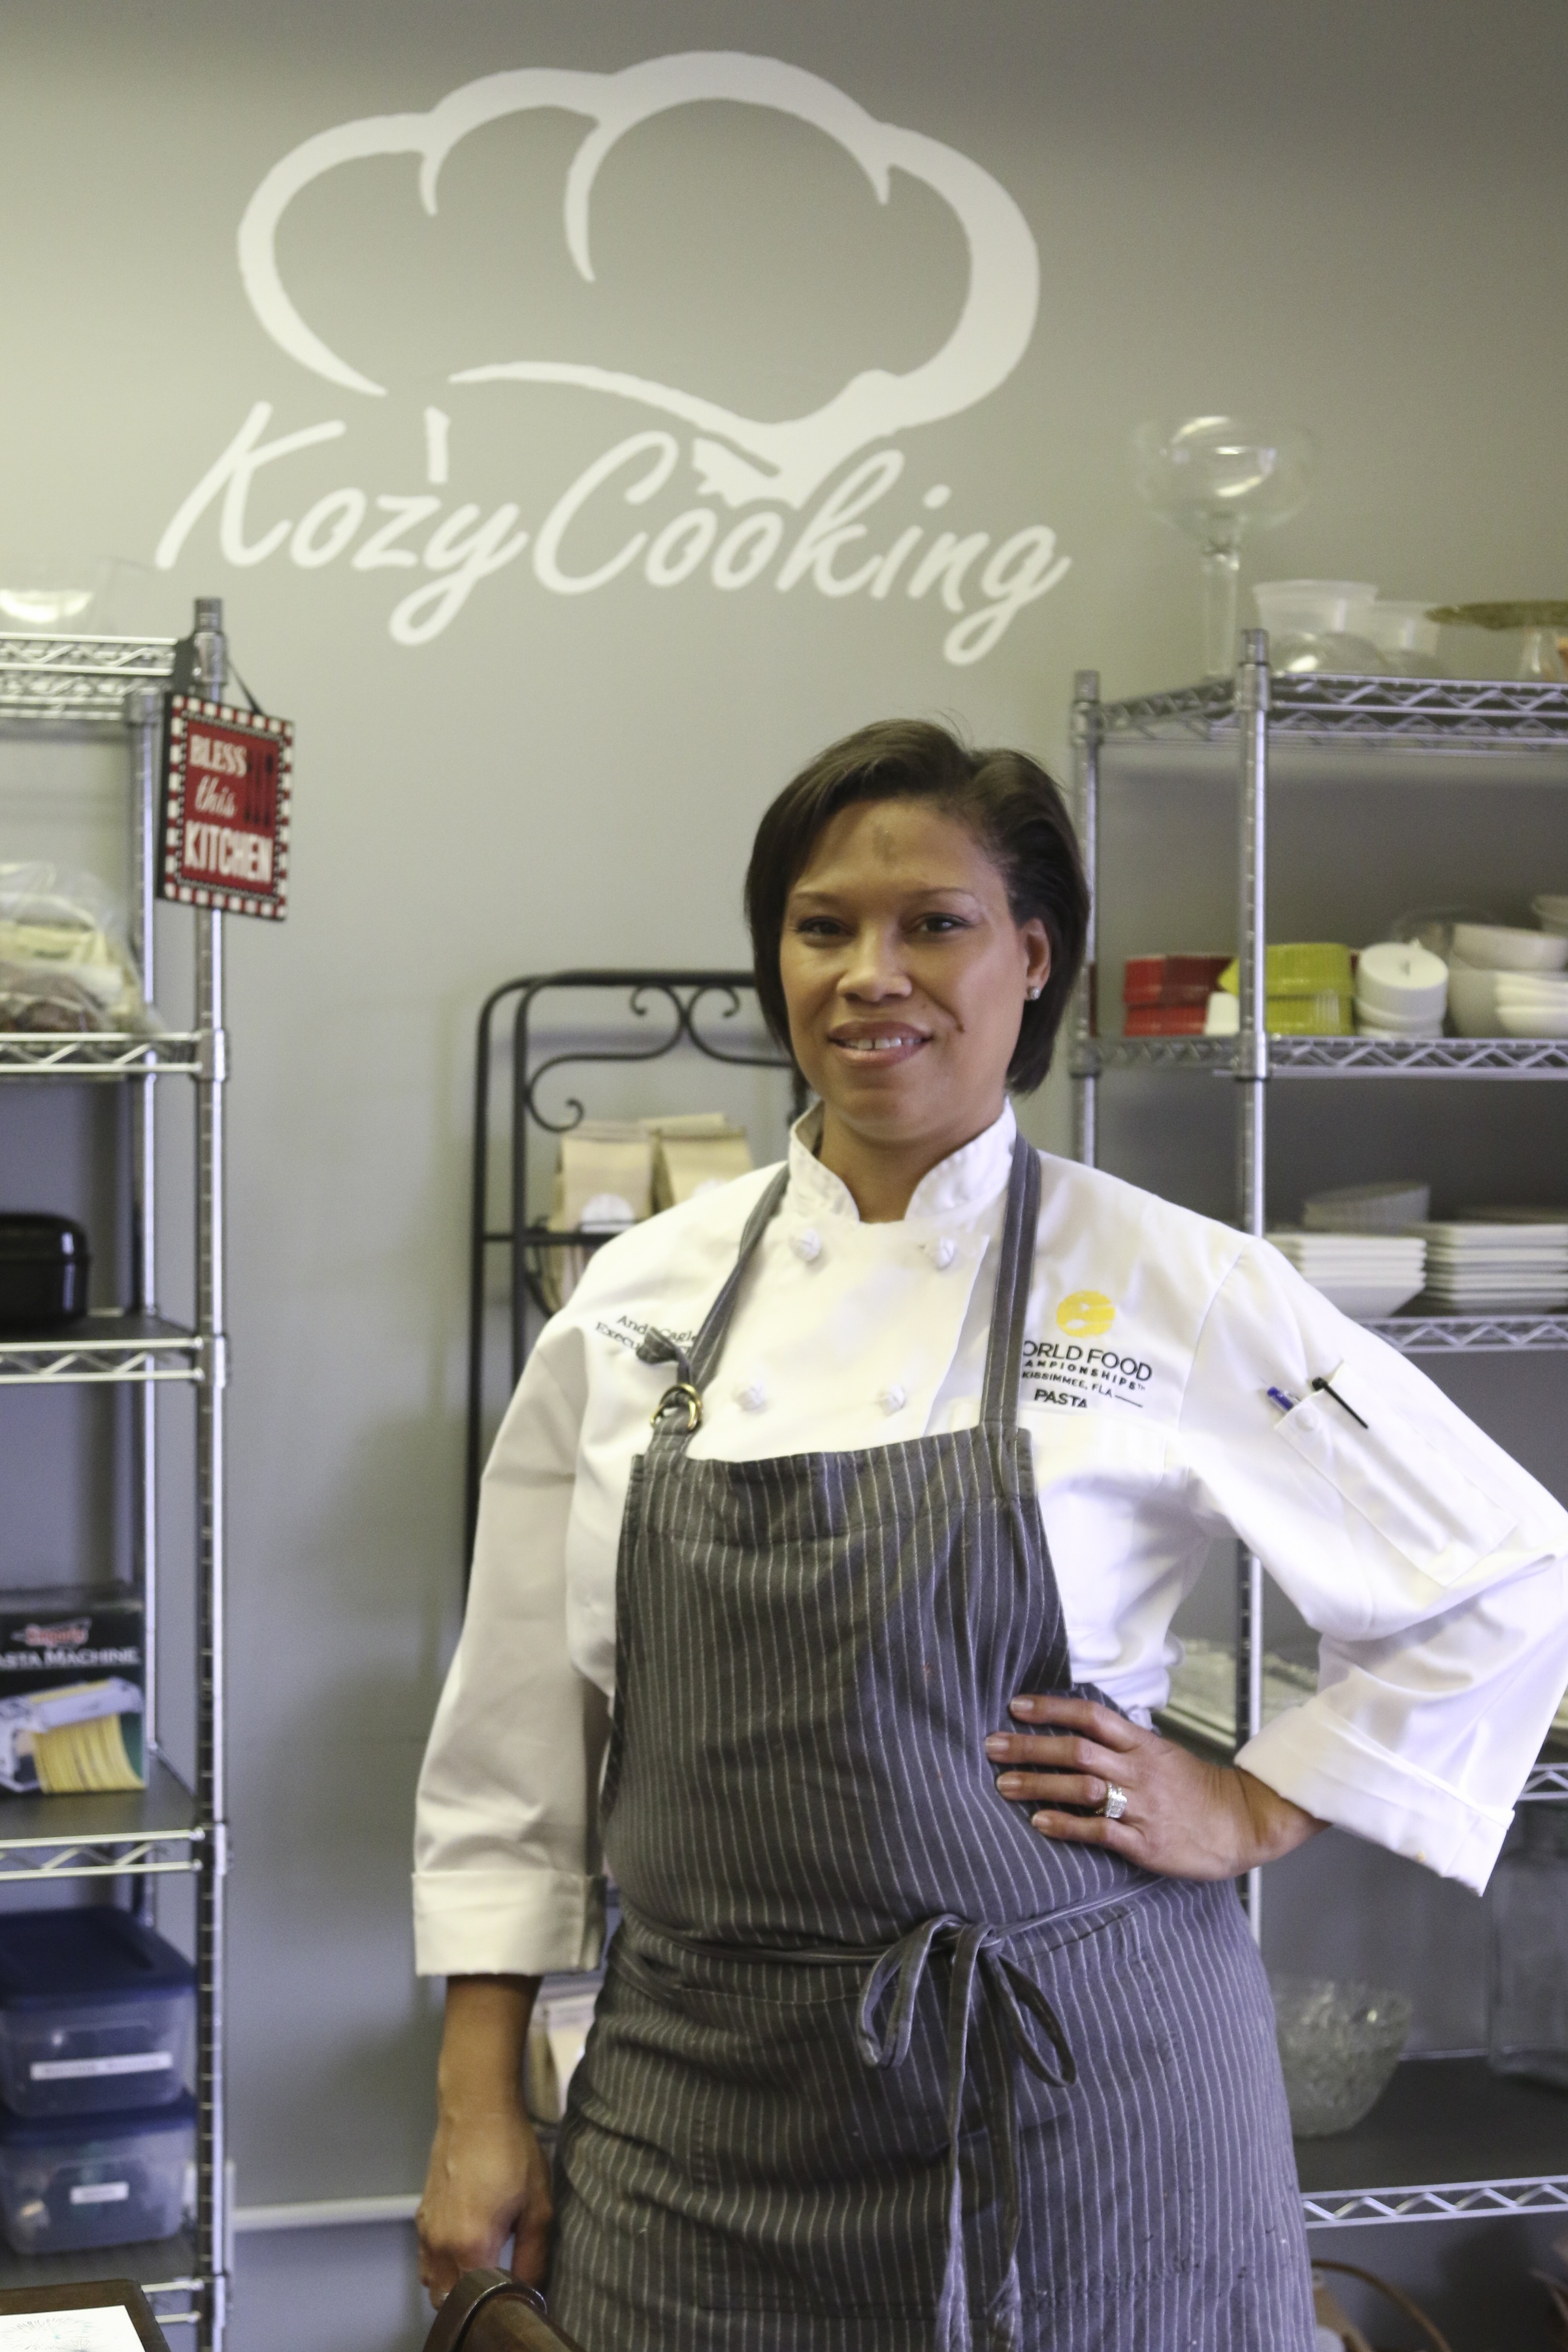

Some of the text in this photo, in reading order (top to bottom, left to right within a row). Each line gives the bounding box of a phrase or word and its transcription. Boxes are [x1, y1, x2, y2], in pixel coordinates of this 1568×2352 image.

[155, 401, 1071, 665] Kozy Cooking
[189, 733, 247, 778] BLESS
[194, 774, 237, 817] this
[184, 819, 274, 883] KITCHEN
[595, 1322, 642, 1350] Execu
[617, 1315, 649, 1335] And
[1022, 1340, 1152, 1382] ORLD FOOD
[1034, 1388, 1088, 1408] PASTA
